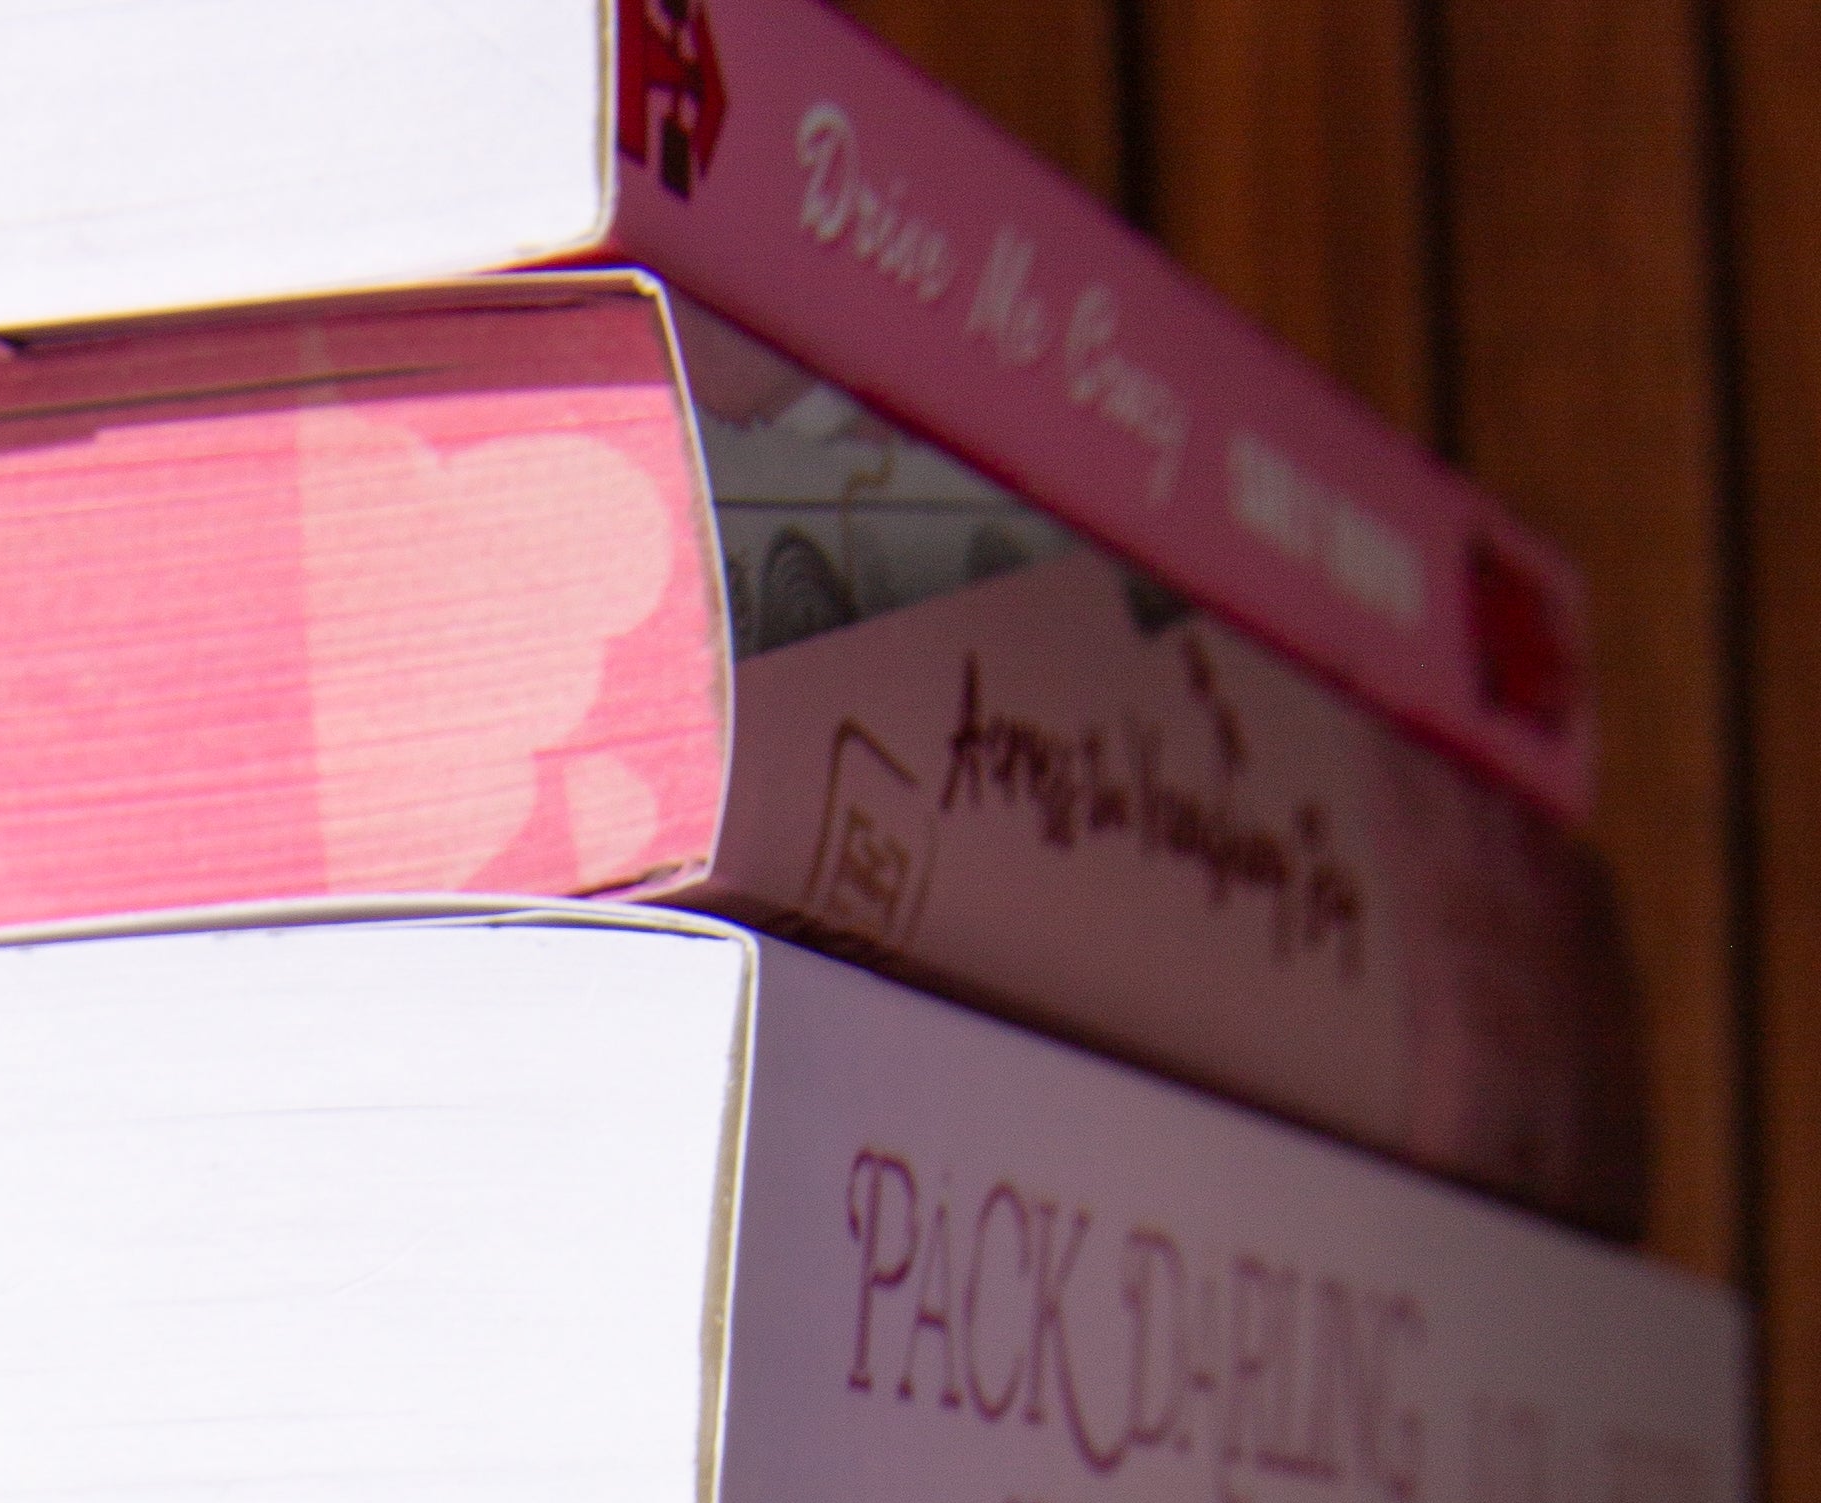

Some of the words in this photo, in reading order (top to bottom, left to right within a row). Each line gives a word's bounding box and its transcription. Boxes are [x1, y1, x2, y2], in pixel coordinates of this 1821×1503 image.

[797, 103, 954, 300] Drive
[966, 224, 1050, 366] Me
[847, 1147, 1126, 1473] PACK
